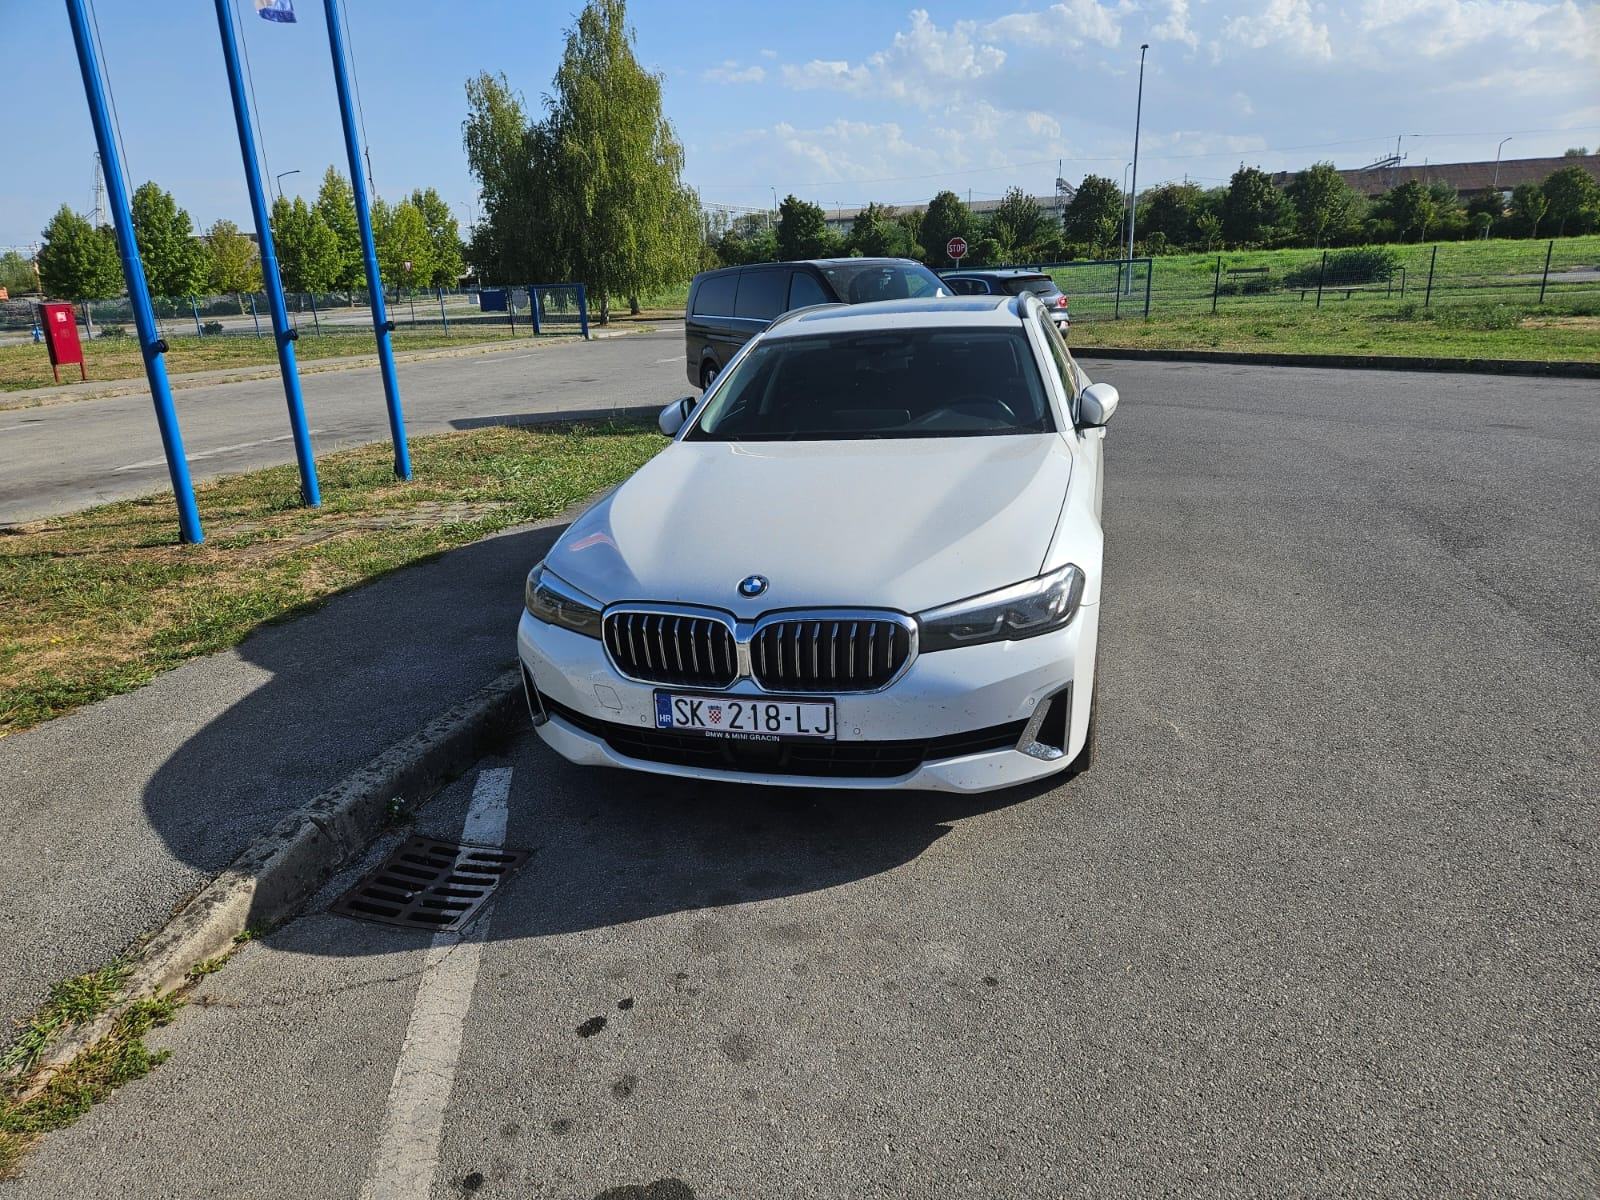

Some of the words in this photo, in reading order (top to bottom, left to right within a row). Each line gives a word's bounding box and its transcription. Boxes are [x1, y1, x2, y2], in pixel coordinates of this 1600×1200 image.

[949, 244, 965, 253] STOP
[659, 714, 671, 722] HR
[674, 698, 706, 727] SK
[727, 702, 831, 734] 218-LJ
